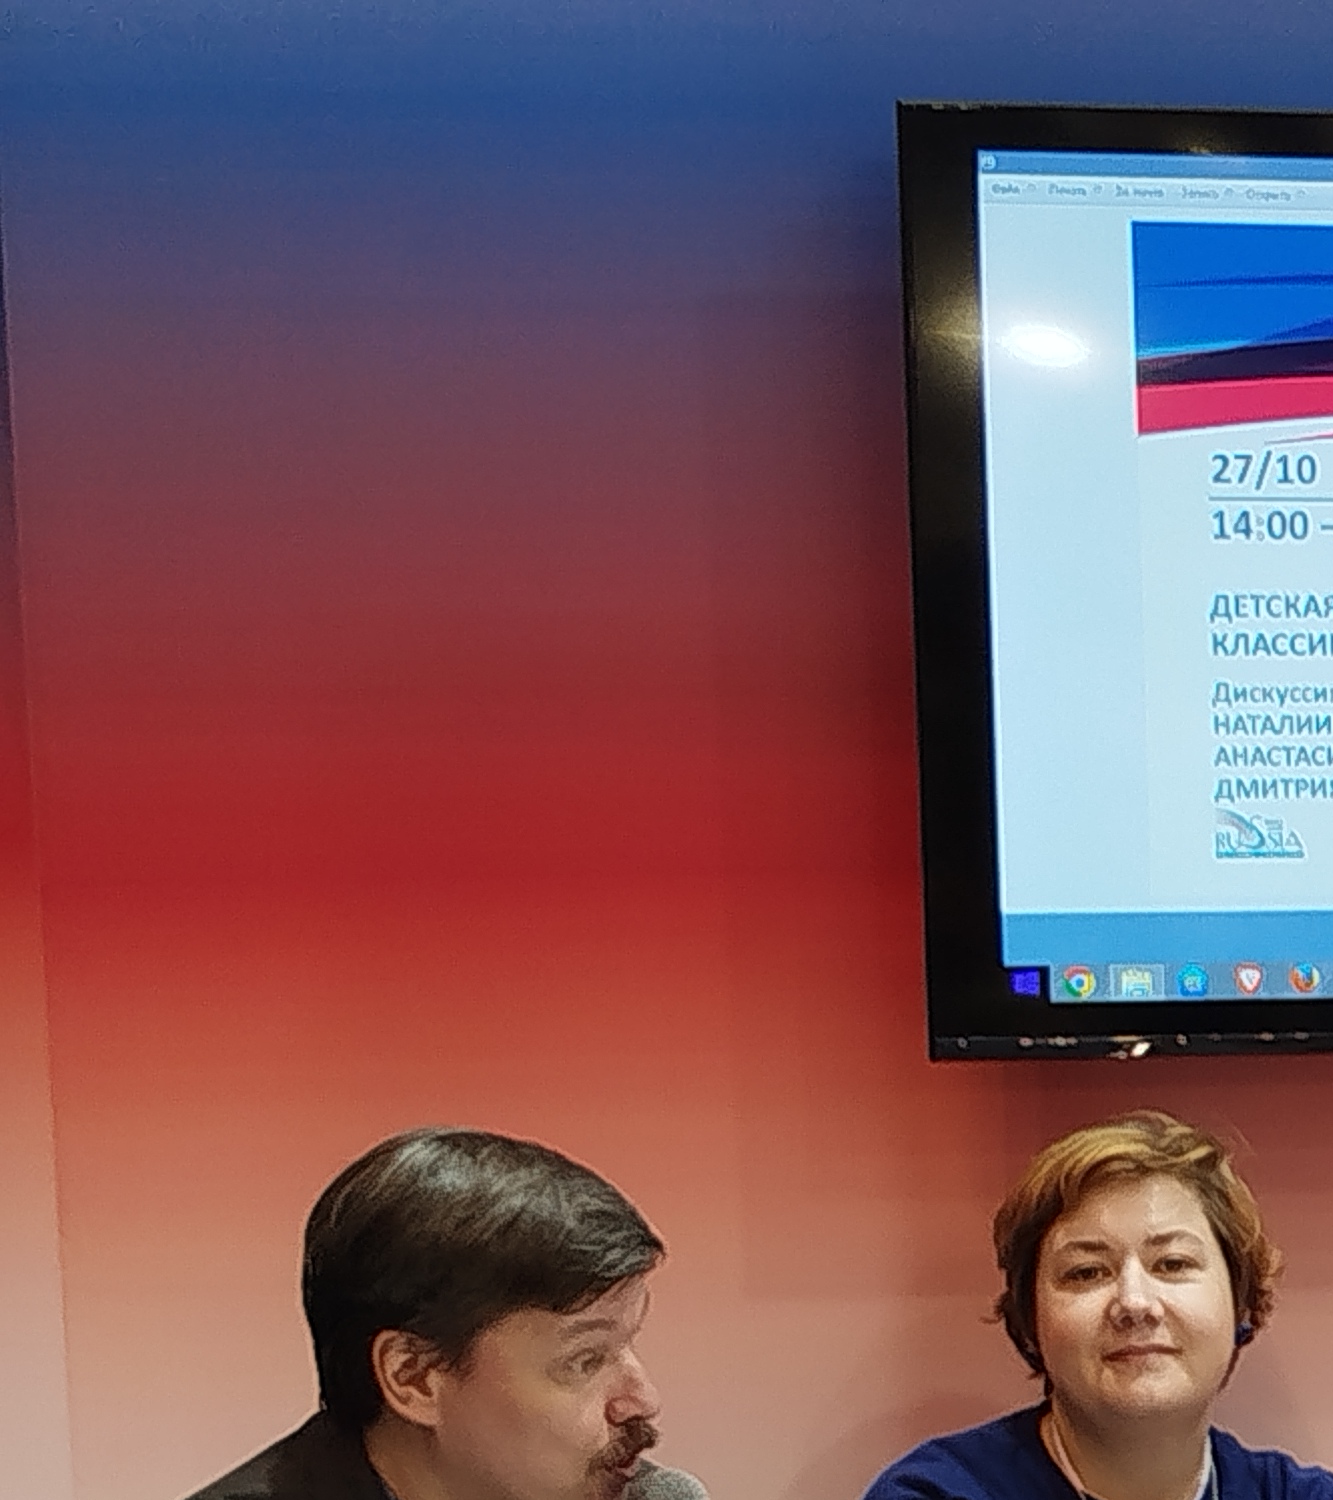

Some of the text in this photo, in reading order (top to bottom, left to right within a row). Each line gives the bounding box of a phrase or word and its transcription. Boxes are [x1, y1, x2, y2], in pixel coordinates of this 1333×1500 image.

[1211, 450, 1317, 490] 27/10
[1213, 510, 1309, 541] 14:00
[1213, 714, 1332, 735] НАТАЛИИ
